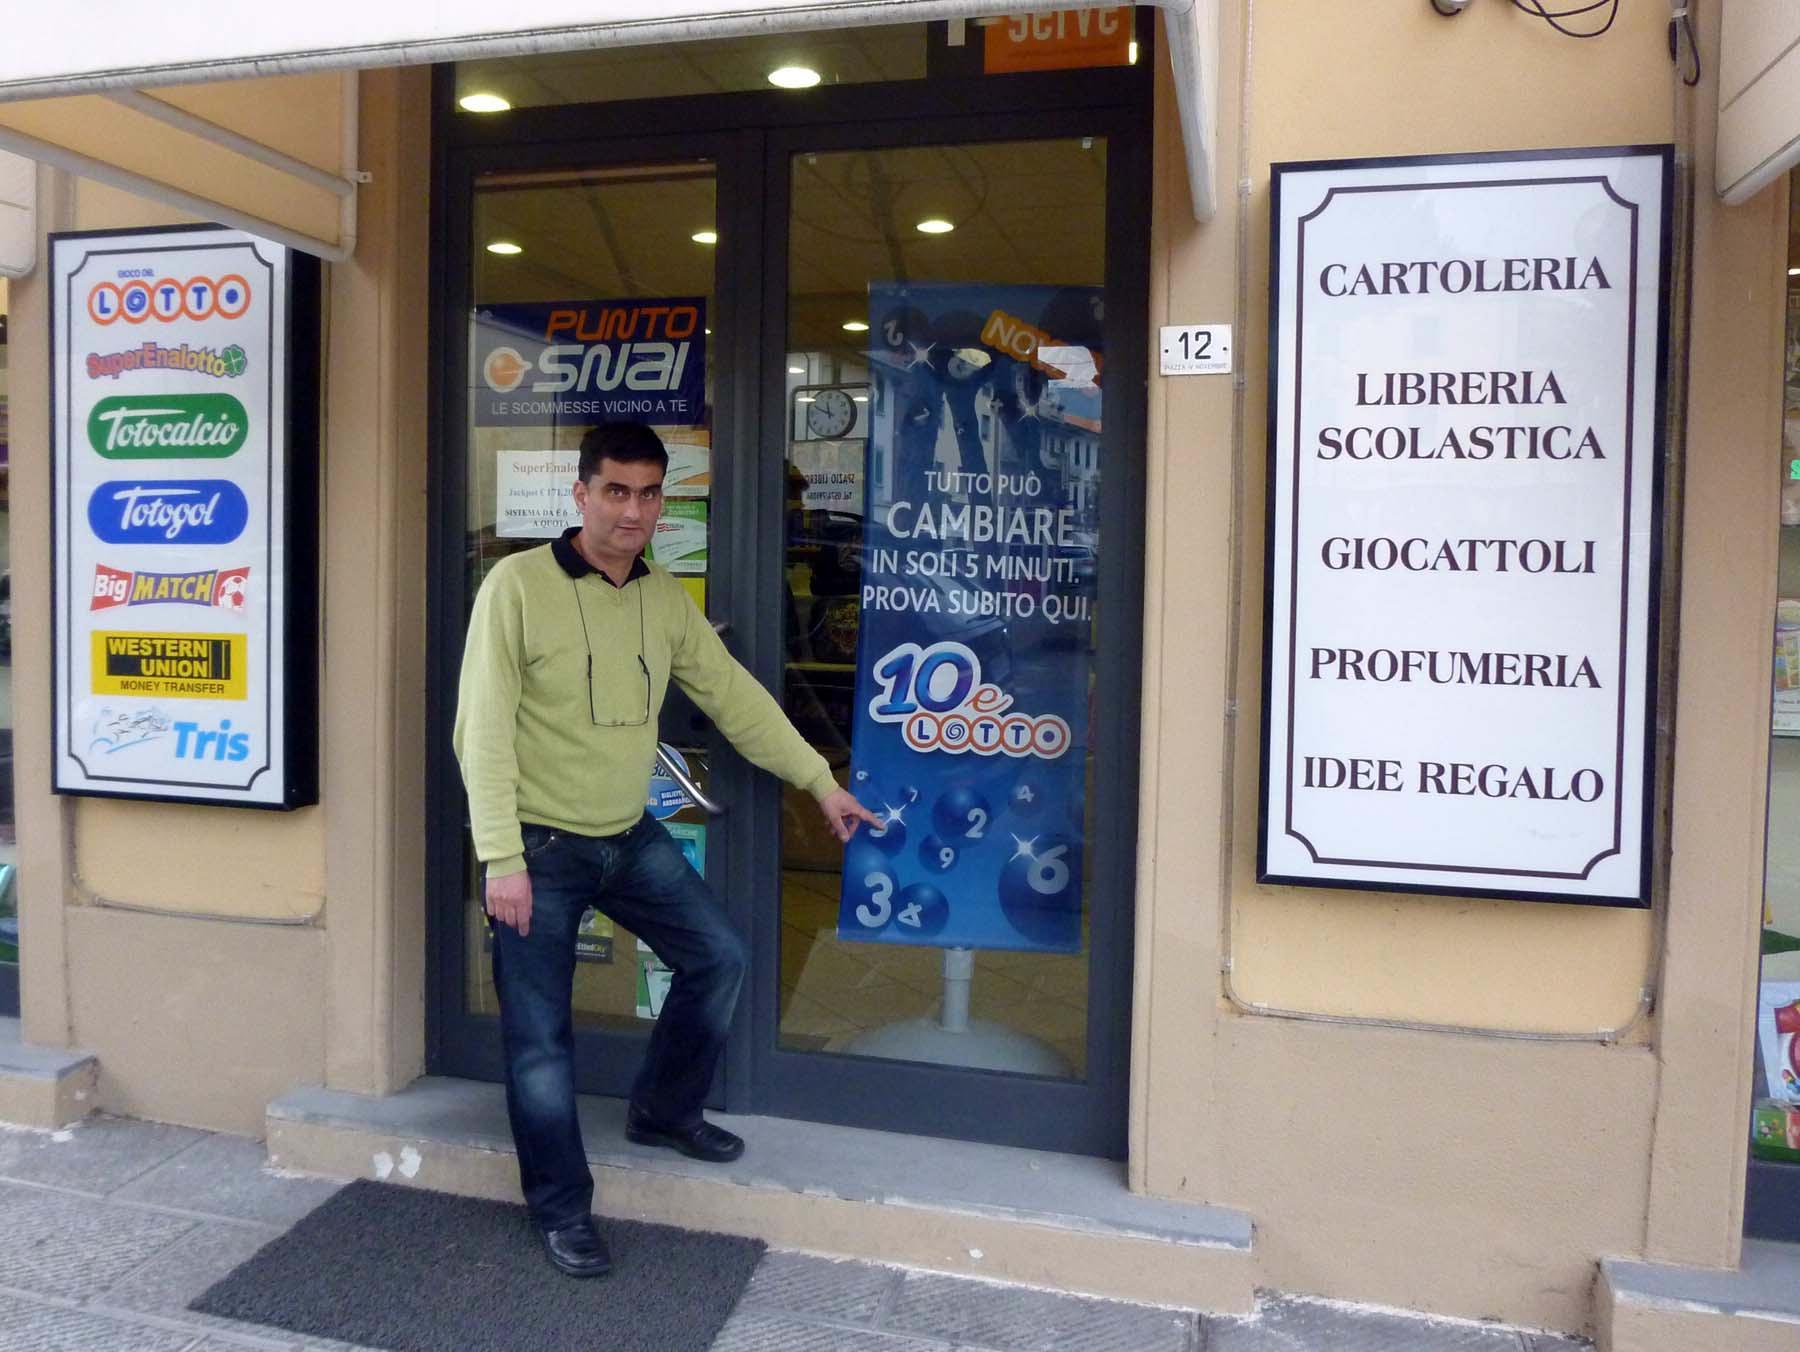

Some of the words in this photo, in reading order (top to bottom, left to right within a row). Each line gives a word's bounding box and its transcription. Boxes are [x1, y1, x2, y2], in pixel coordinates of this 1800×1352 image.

[1319, 255, 1613, 297] CARTOLERIA
[91, 277, 248, 321] LOTTO
[545, 306, 698, 343] PUNTO
[86, 342, 225, 379] SuperEnalotto
[1178, 331, 1211, 360] 12
[1355, 369, 1568, 407] LIBRERIA
[491, 402, 507, 415] LE
[511, 401, 600, 415] SCOMMESSE
[603, 400, 652, 414] VICINO
[655, 400, 666, 413] A
[670, 400, 688, 413] TE
[98, 406, 240, 450] Totocalcio
[1316, 426, 1607, 461] SCOLASTICA
[512, 462, 577, 475] SuperEnalo
[924, 471, 991, 495] TUTTO
[998, 471, 1042, 497] PUÒ
[113, 486, 220, 539] Totogol
[887, 501, 1075, 547] CAMBIARE
[872, 549, 899, 575] IN
[905, 551, 957, 578] SOLI
[965, 554, 979, 579] 5
[986, 555, 1080, 584] MINUTI.
[1321, 537, 1597, 574] GIOCATTOLI
[94, 574, 127, 601] Big
[133, 574, 214, 601] MATCH
[862, 585, 941, 613] PROVA
[947, 591, 1035, 618] SUBITO
[1042, 594, 1092, 625] QUI.
[108, 638, 208, 657] WESTERN
[141, 659, 208, 678] UNION
[873, 647, 976, 718] 10
[1309, 647, 1602, 688] PROFUMERIA
[120, 680, 160, 692] MONEY
[164, 682, 225, 694] TRANSFER
[173, 719, 249, 761] Tris
[907, 714, 1065, 754] LOTTO
[1304, 756, 1404, 792] IDEE
[1417, 761, 1604, 803] REGALO
[965, 808, 987, 838] 2
[939, 847, 954, 869] 9
[1027, 845, 1069, 894] 6
[856, 872, 893, 928] 3
